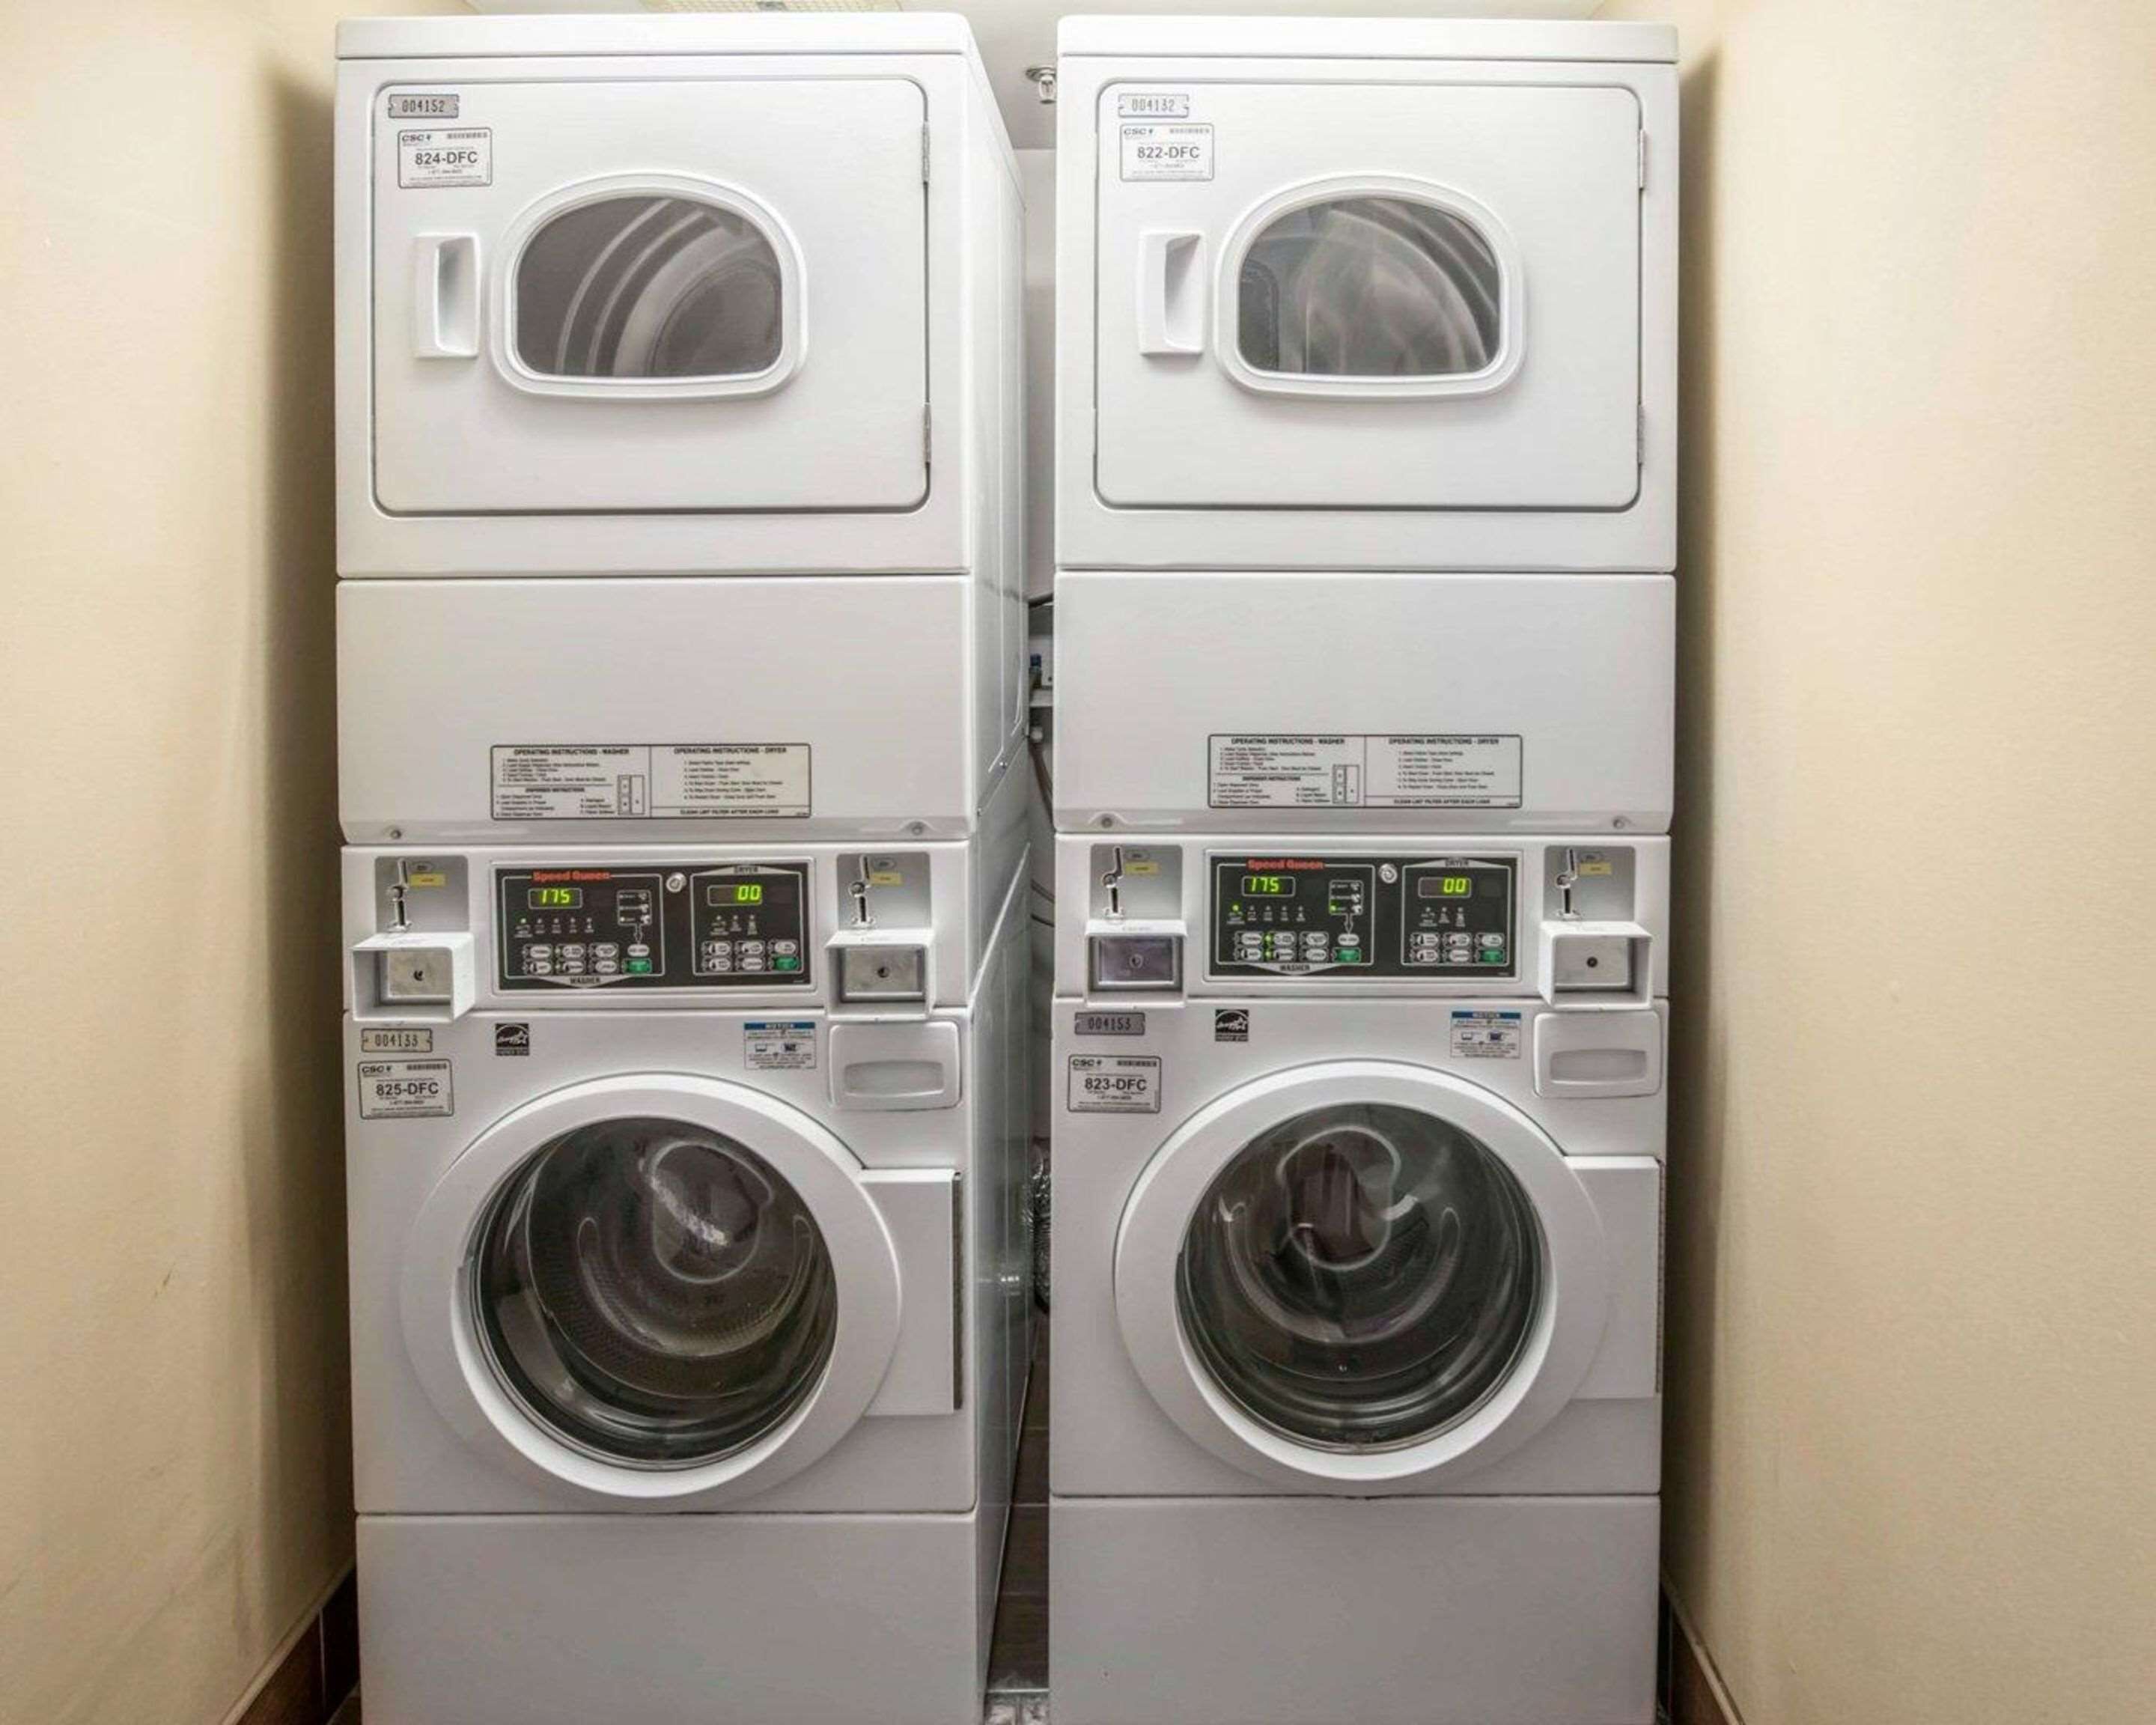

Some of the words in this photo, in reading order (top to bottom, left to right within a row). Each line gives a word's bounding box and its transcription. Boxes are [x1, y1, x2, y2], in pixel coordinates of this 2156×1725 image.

[402, 100, 445, 113] 004152
[1131, 98, 1175, 112] 004132
[401, 134, 424, 142] CSC
[415, 151, 478, 165] 824-DFC
[1137, 146, 1201, 159] 822-DFC
[1251, 877, 1280, 892] 175
[1443, 877, 1467, 893] 00
[542, 889, 570, 904] 175
[737, 885, 761, 901] 00
[1088, 1016, 1132, 1031] 004153
[375, 1034, 418, 1047] 004133
[1072, 1059, 1094, 1067] CSC
[376, 1082, 439, 1097] 825-DFC
[1085, 1078, 1147, 1092] 823-DFC
